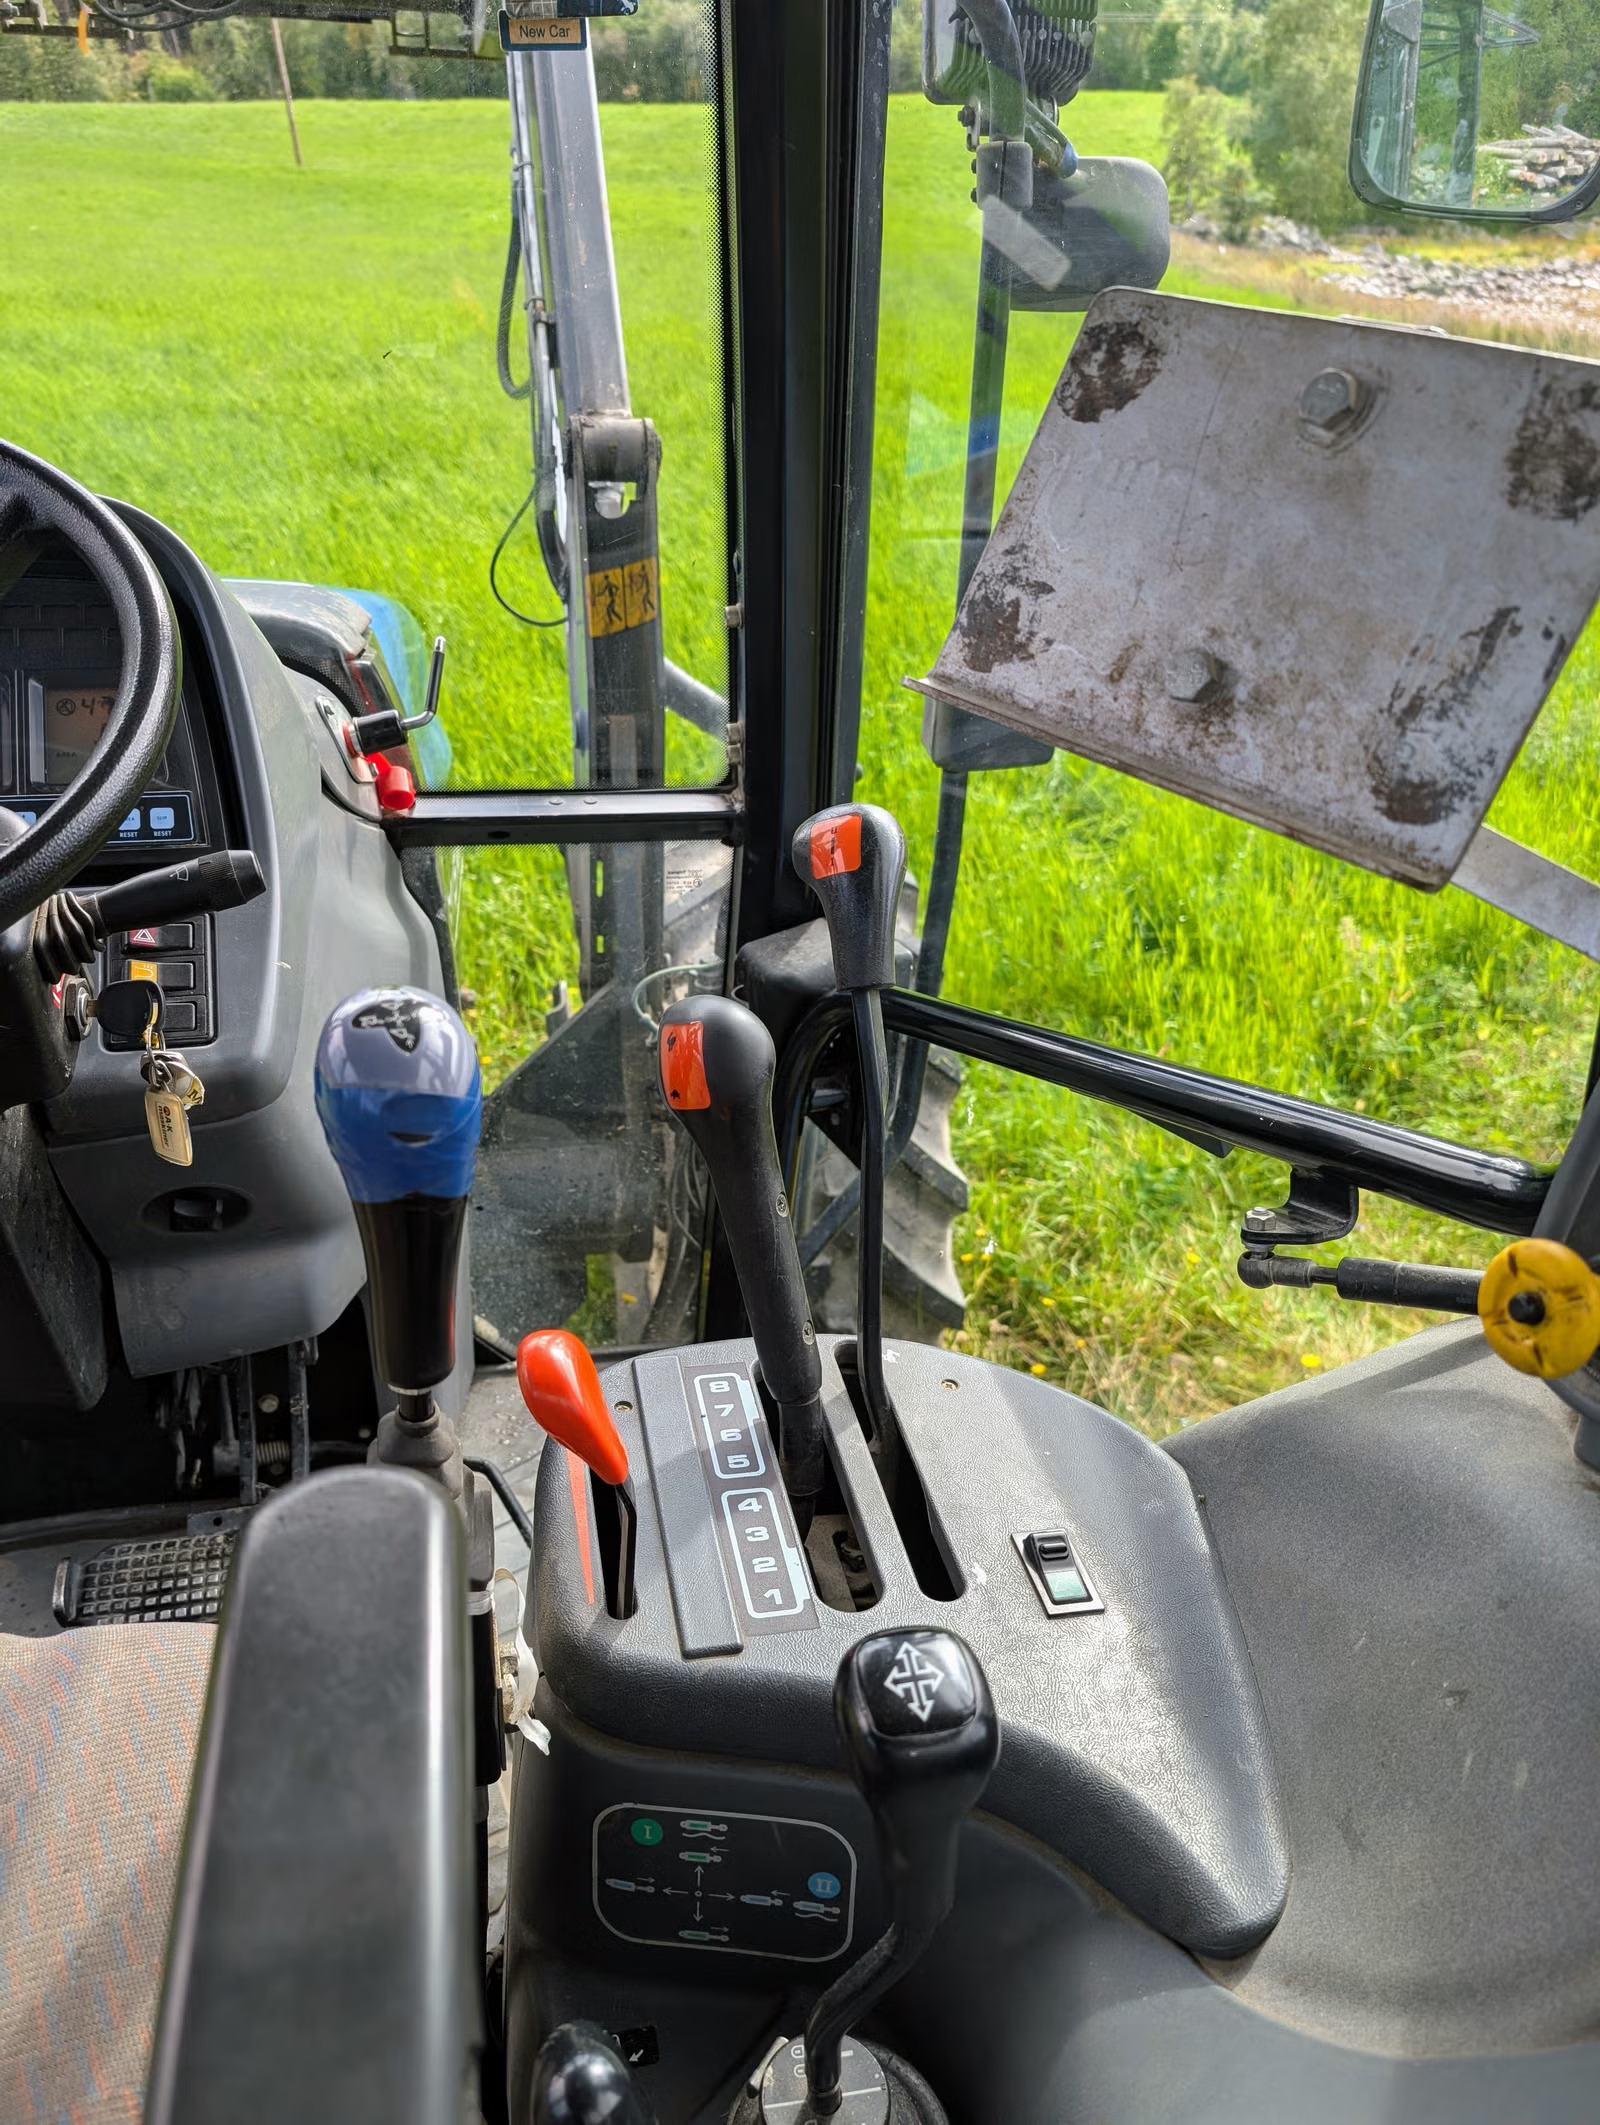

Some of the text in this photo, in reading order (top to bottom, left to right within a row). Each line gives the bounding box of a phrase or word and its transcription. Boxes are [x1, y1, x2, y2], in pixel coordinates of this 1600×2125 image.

[519, 25, 570, 38] New Car
[708, 1380, 731, 1393] 8
[713, 1403, 735, 1417] 7
[719, 1428, 742, 1442] 6
[726, 1454, 751, 1469] 5
[737, 1497, 763, 1512] 4
[744, 1526, 770, 1542] 3
[751, 1556, 778, 1573] 2
[762, 1588, 783, 1605] 1
